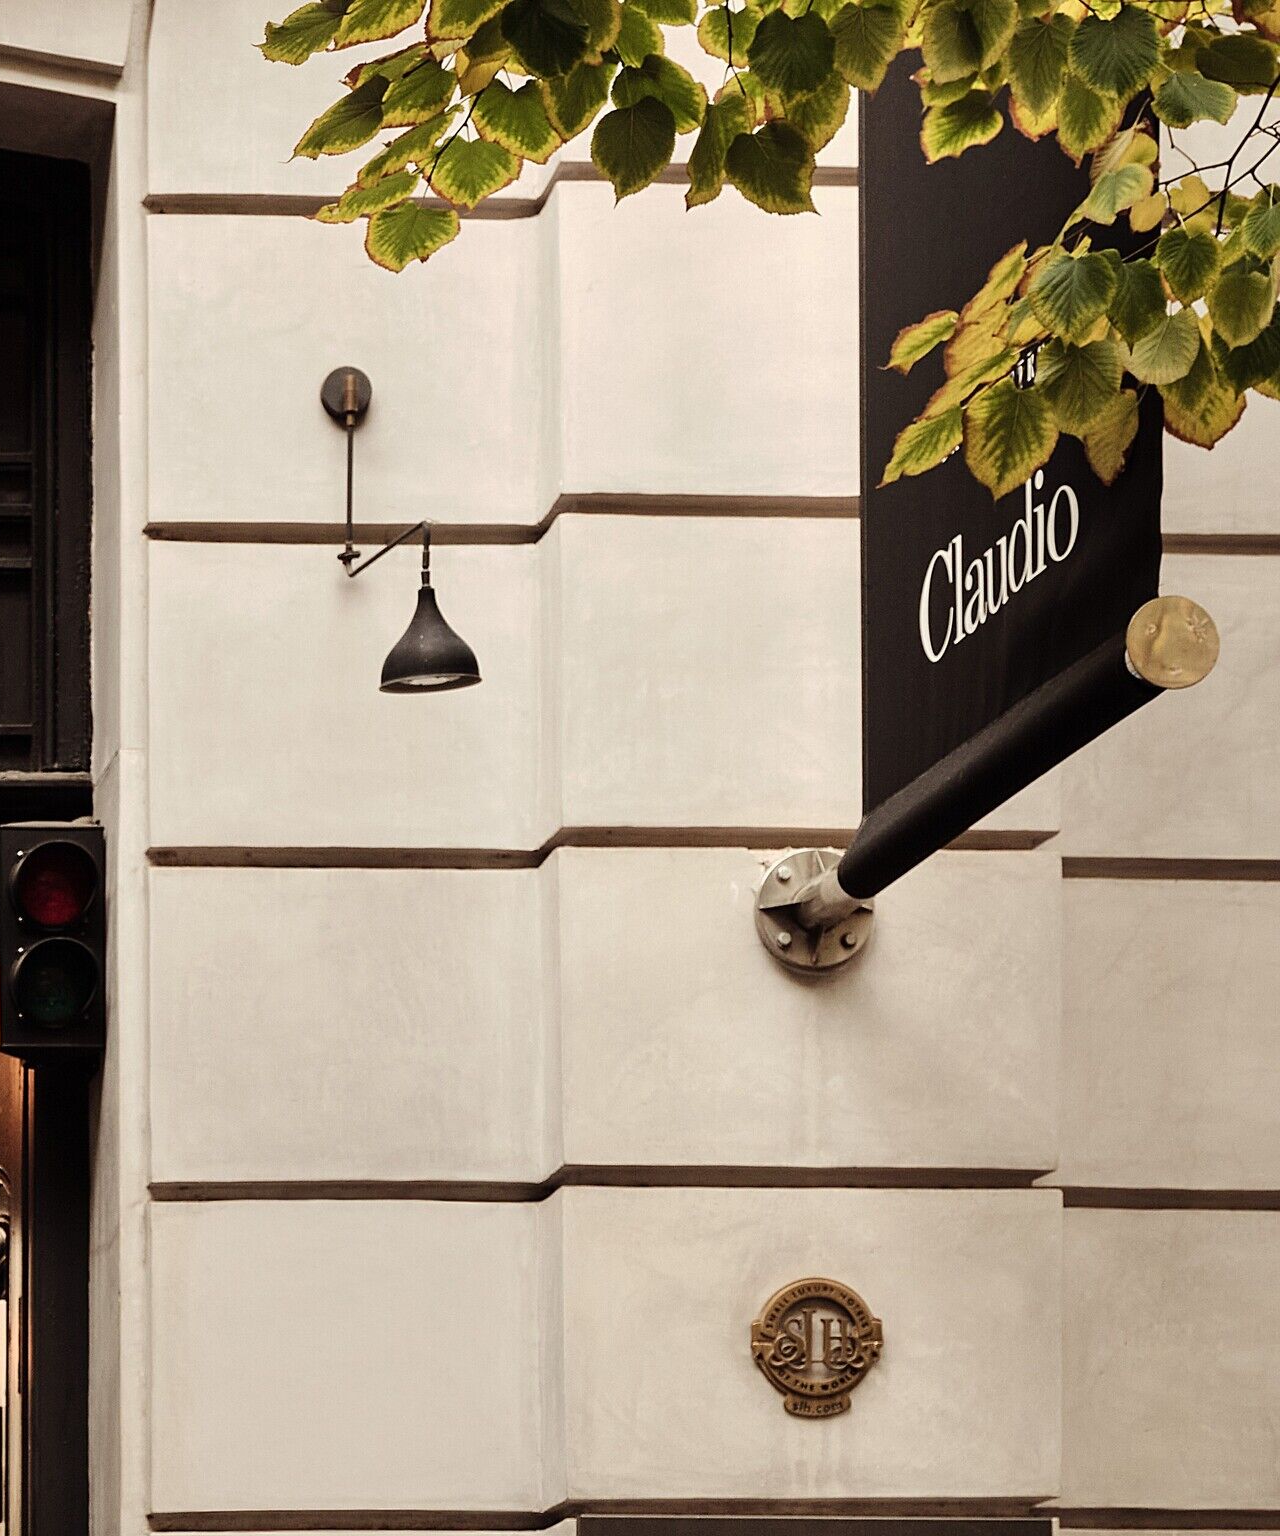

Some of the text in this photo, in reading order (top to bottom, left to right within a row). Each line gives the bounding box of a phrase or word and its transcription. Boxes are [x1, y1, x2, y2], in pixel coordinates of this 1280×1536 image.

[919, 469, 1079, 663] Claudio
[764, 1298, 790, 1329] SMALL
[839, 1291, 870, 1329] HOTELS
